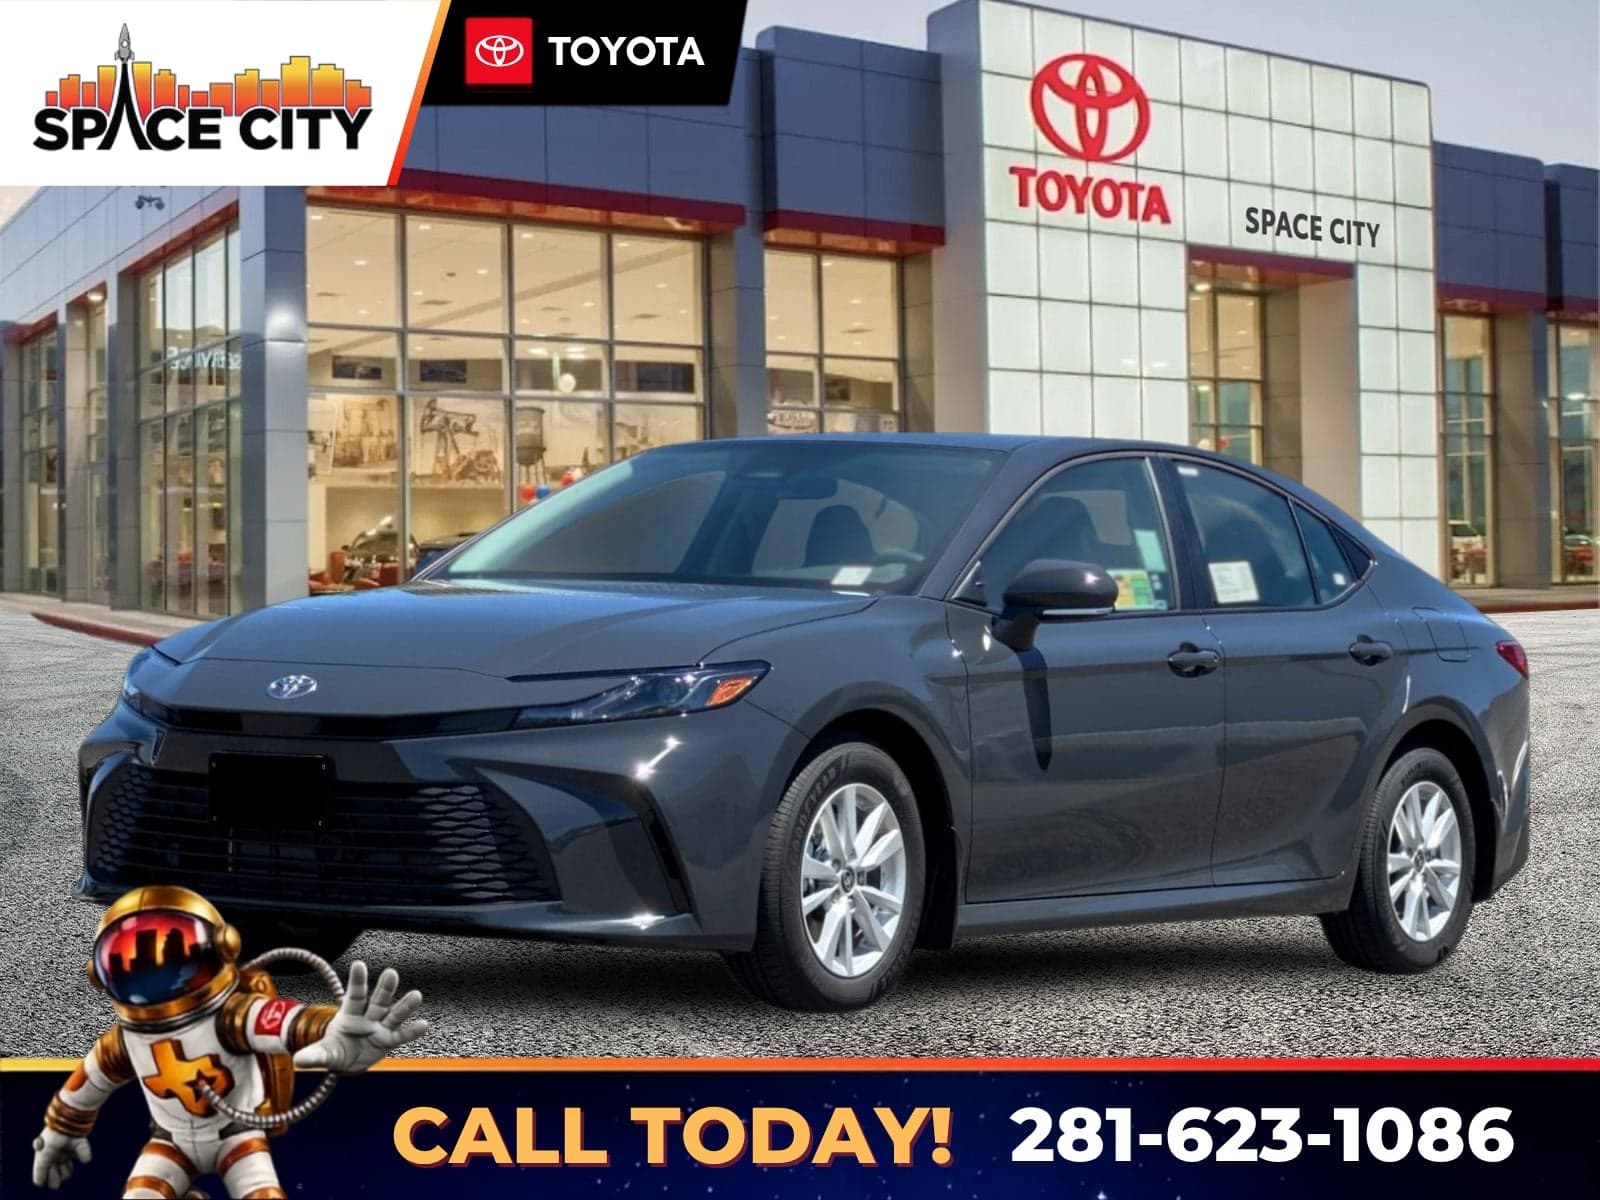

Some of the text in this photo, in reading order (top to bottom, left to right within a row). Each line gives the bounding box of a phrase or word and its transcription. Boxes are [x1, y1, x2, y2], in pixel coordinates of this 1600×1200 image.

[1009, 166, 1171, 224] TOYOTA
[1245, 206, 1381, 248] SPACE CITY
